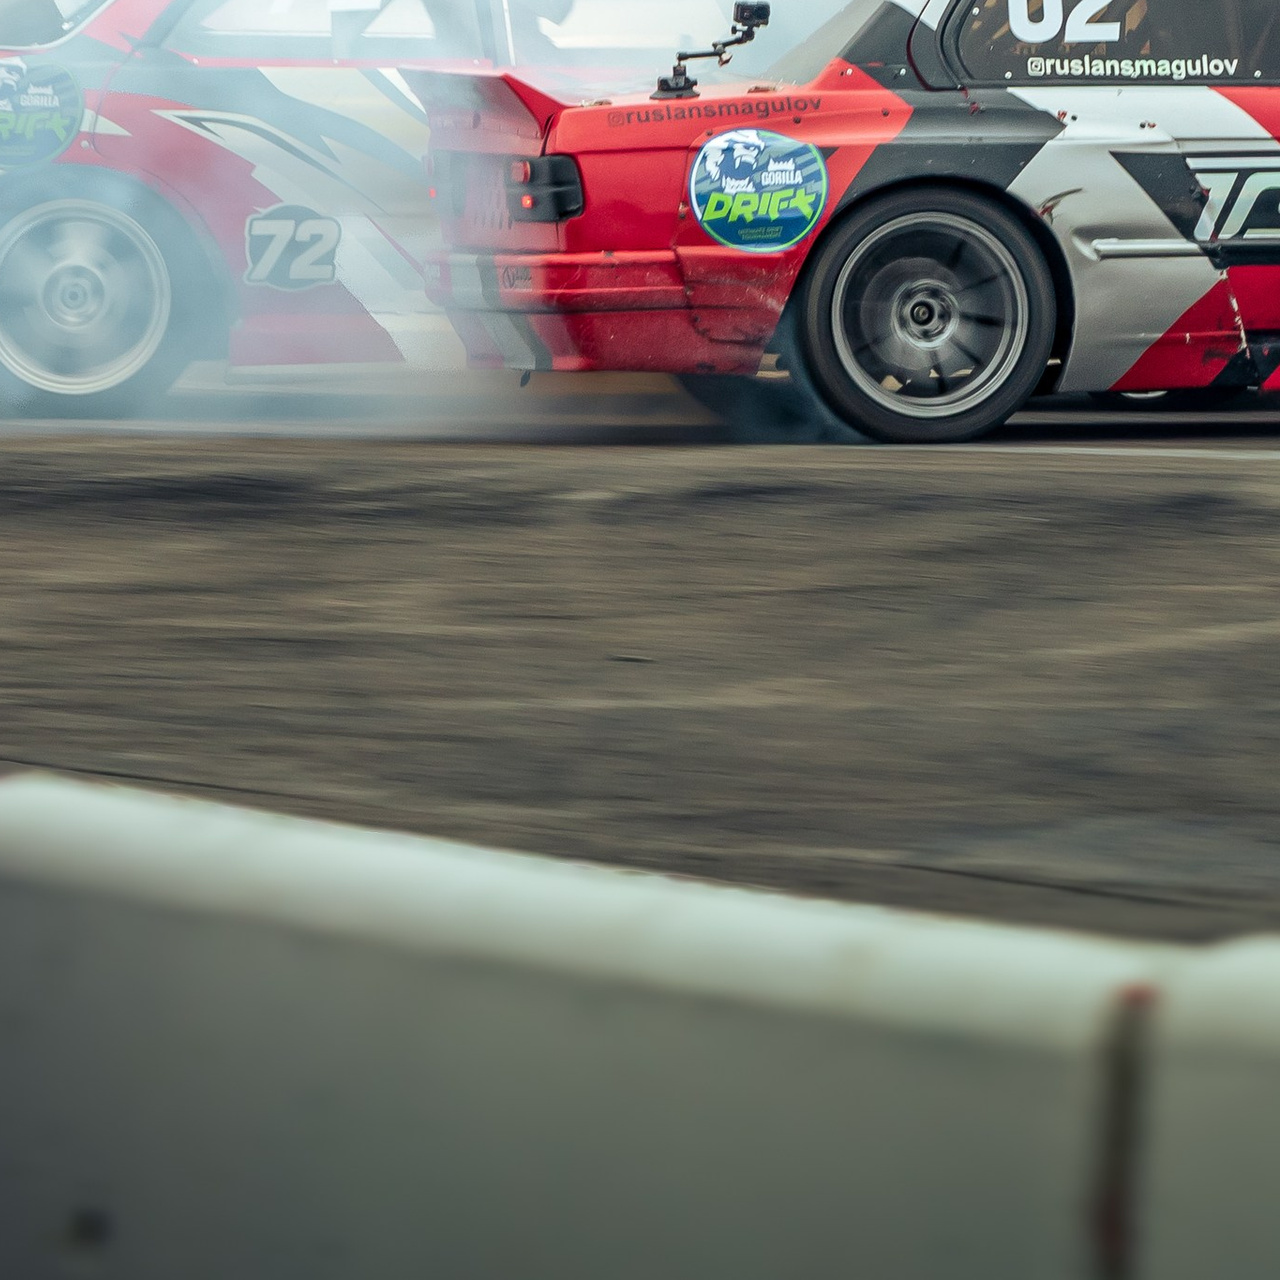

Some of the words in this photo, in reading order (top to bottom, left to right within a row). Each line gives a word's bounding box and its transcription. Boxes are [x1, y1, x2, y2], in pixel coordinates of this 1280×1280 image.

[20, 93, 60, 108] GORILLA
[761, 170, 803, 186] GORILLA
[702, 187, 817, 223] DRIFT
[248, 219, 339, 281] 72
